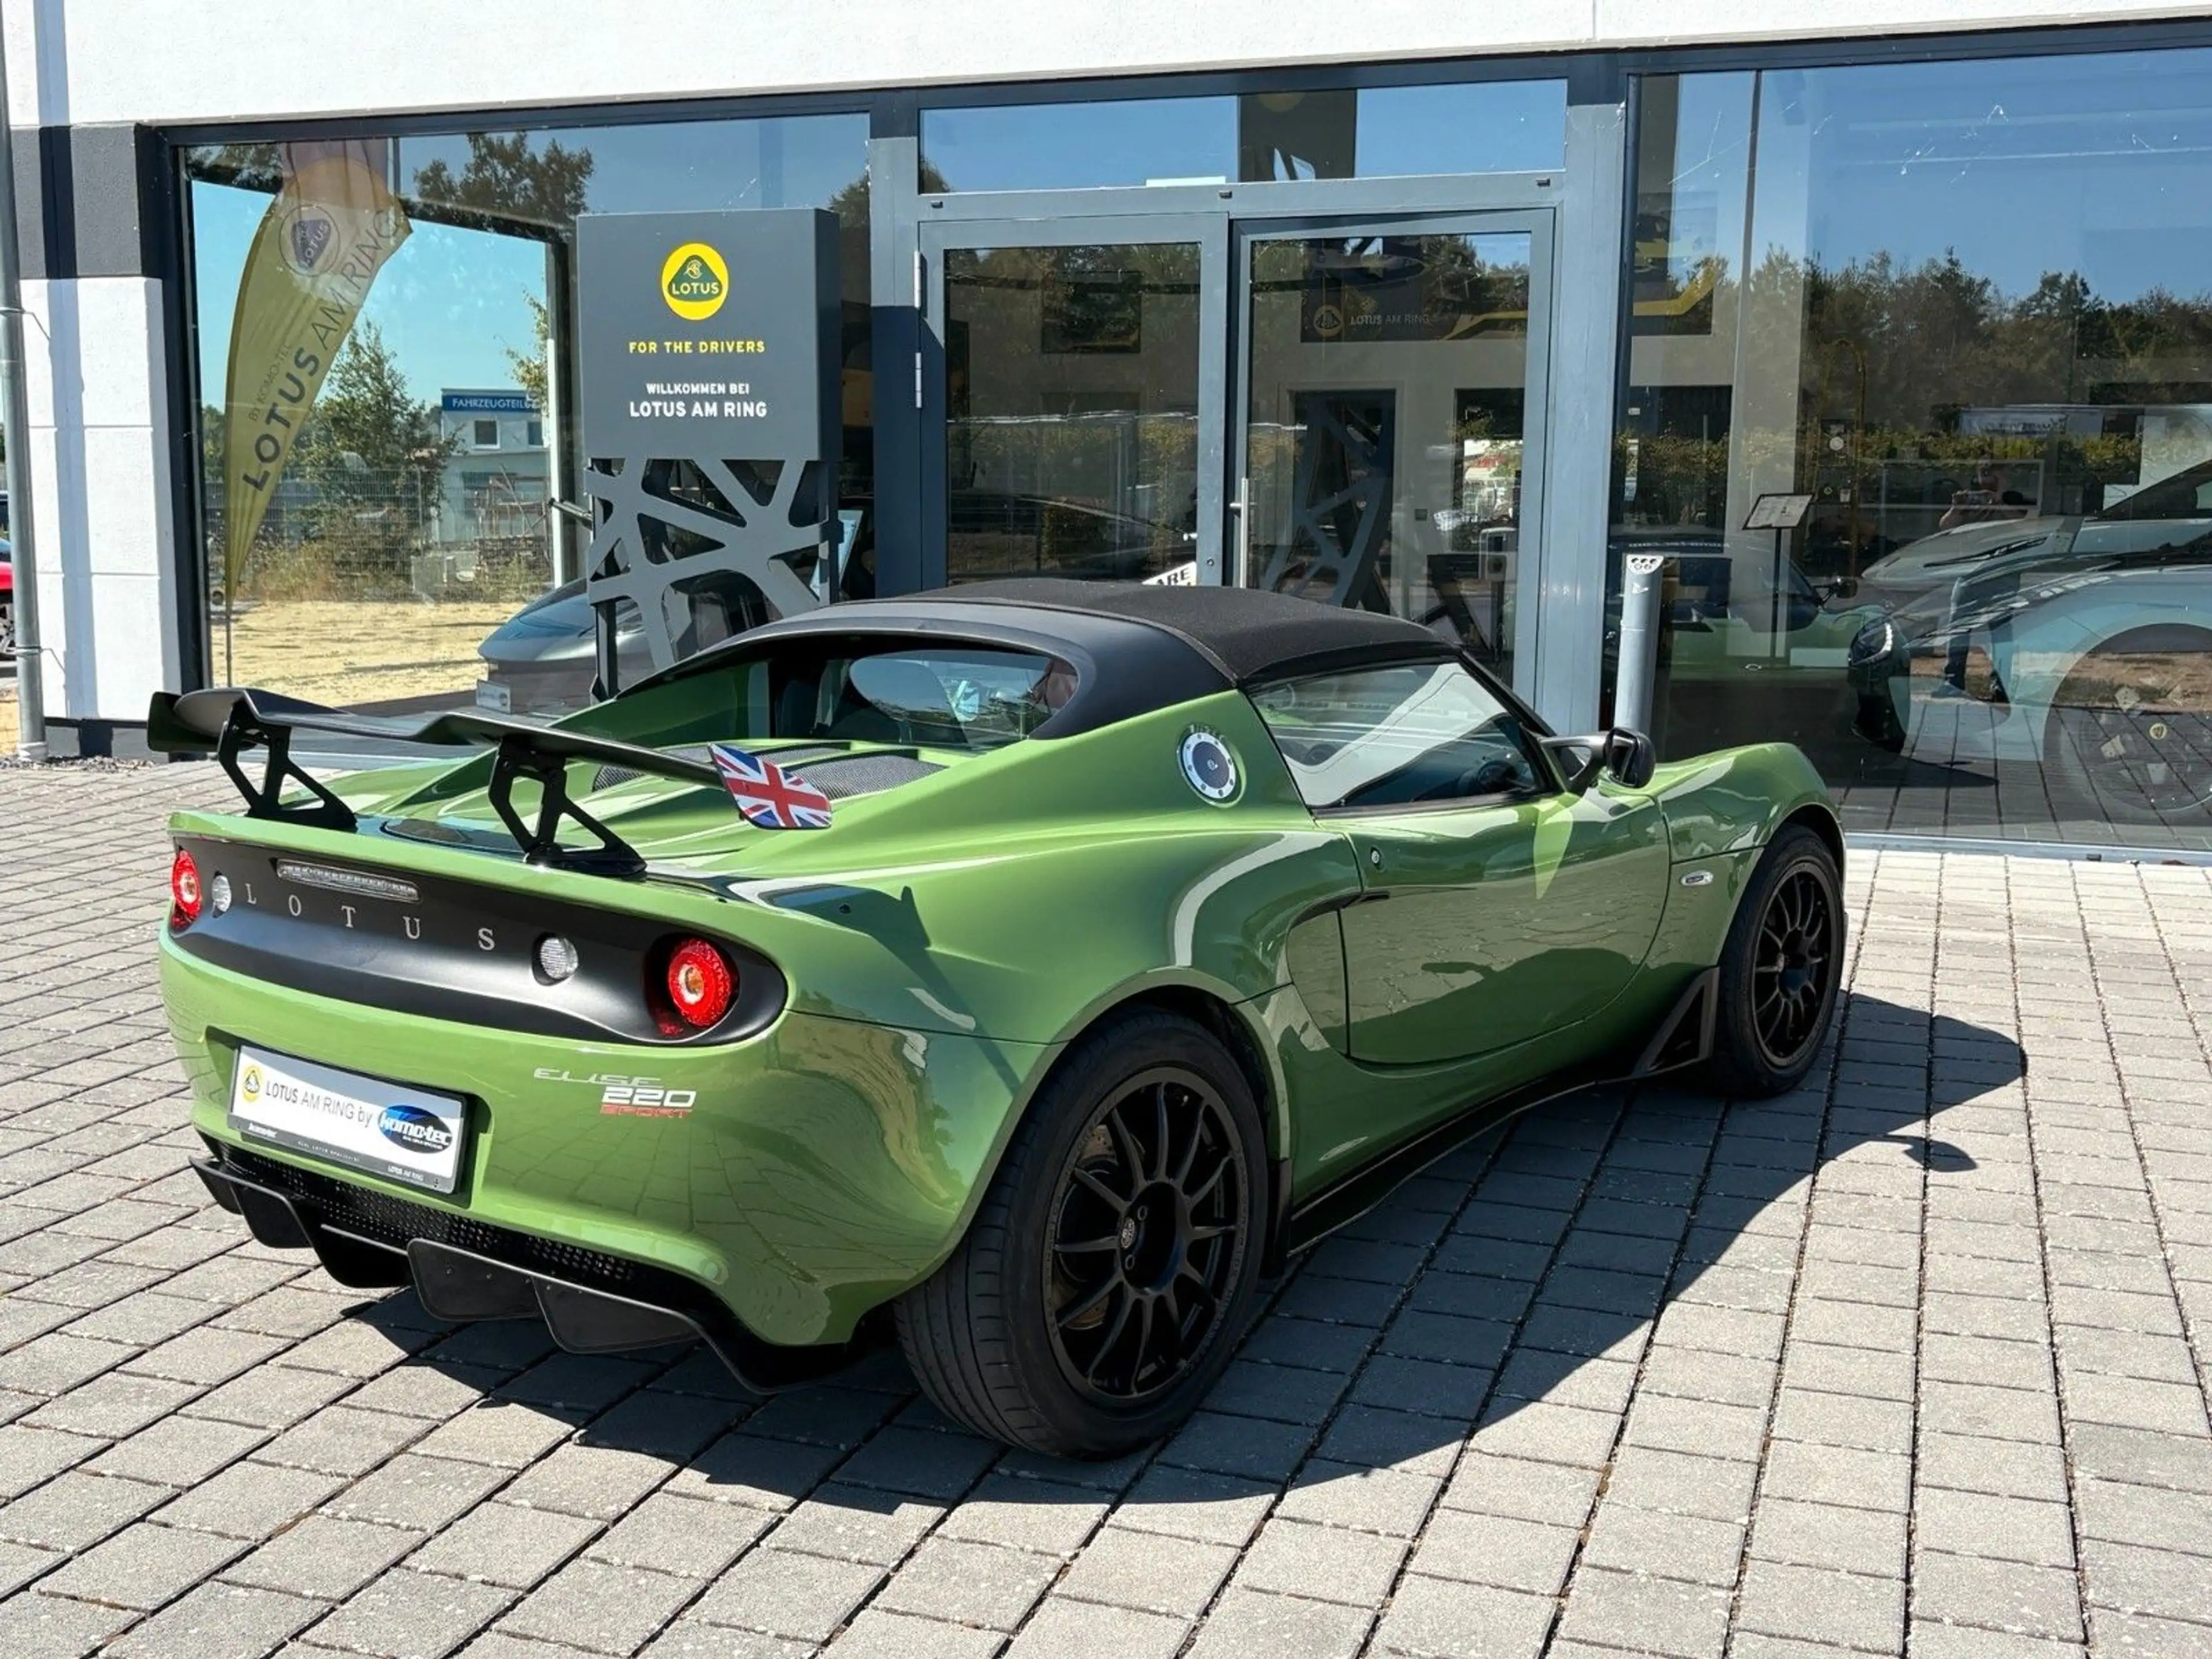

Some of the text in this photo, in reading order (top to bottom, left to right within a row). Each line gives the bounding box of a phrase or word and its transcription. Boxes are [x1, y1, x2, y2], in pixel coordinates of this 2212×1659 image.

[671, 282, 719, 295] LOTUS
[1350, 314, 1382, 325] LOTUS
[242, 210, 399, 491] LOTUS AM RING
[628, 340, 765, 353] FOR THE DRIVERS
[646, 382, 749, 395] WILLKOMMEN BEI
[630, 401, 767, 418] LOTUS AM RING
[245, 883, 495, 950] LOTUS
[533, 1067, 664, 1088] ELISE
[266, 1081, 373, 1128] LOTUS AM RING by
[601, 1086, 696, 1107] 220
[601, 1104, 693, 1118] SPORT
